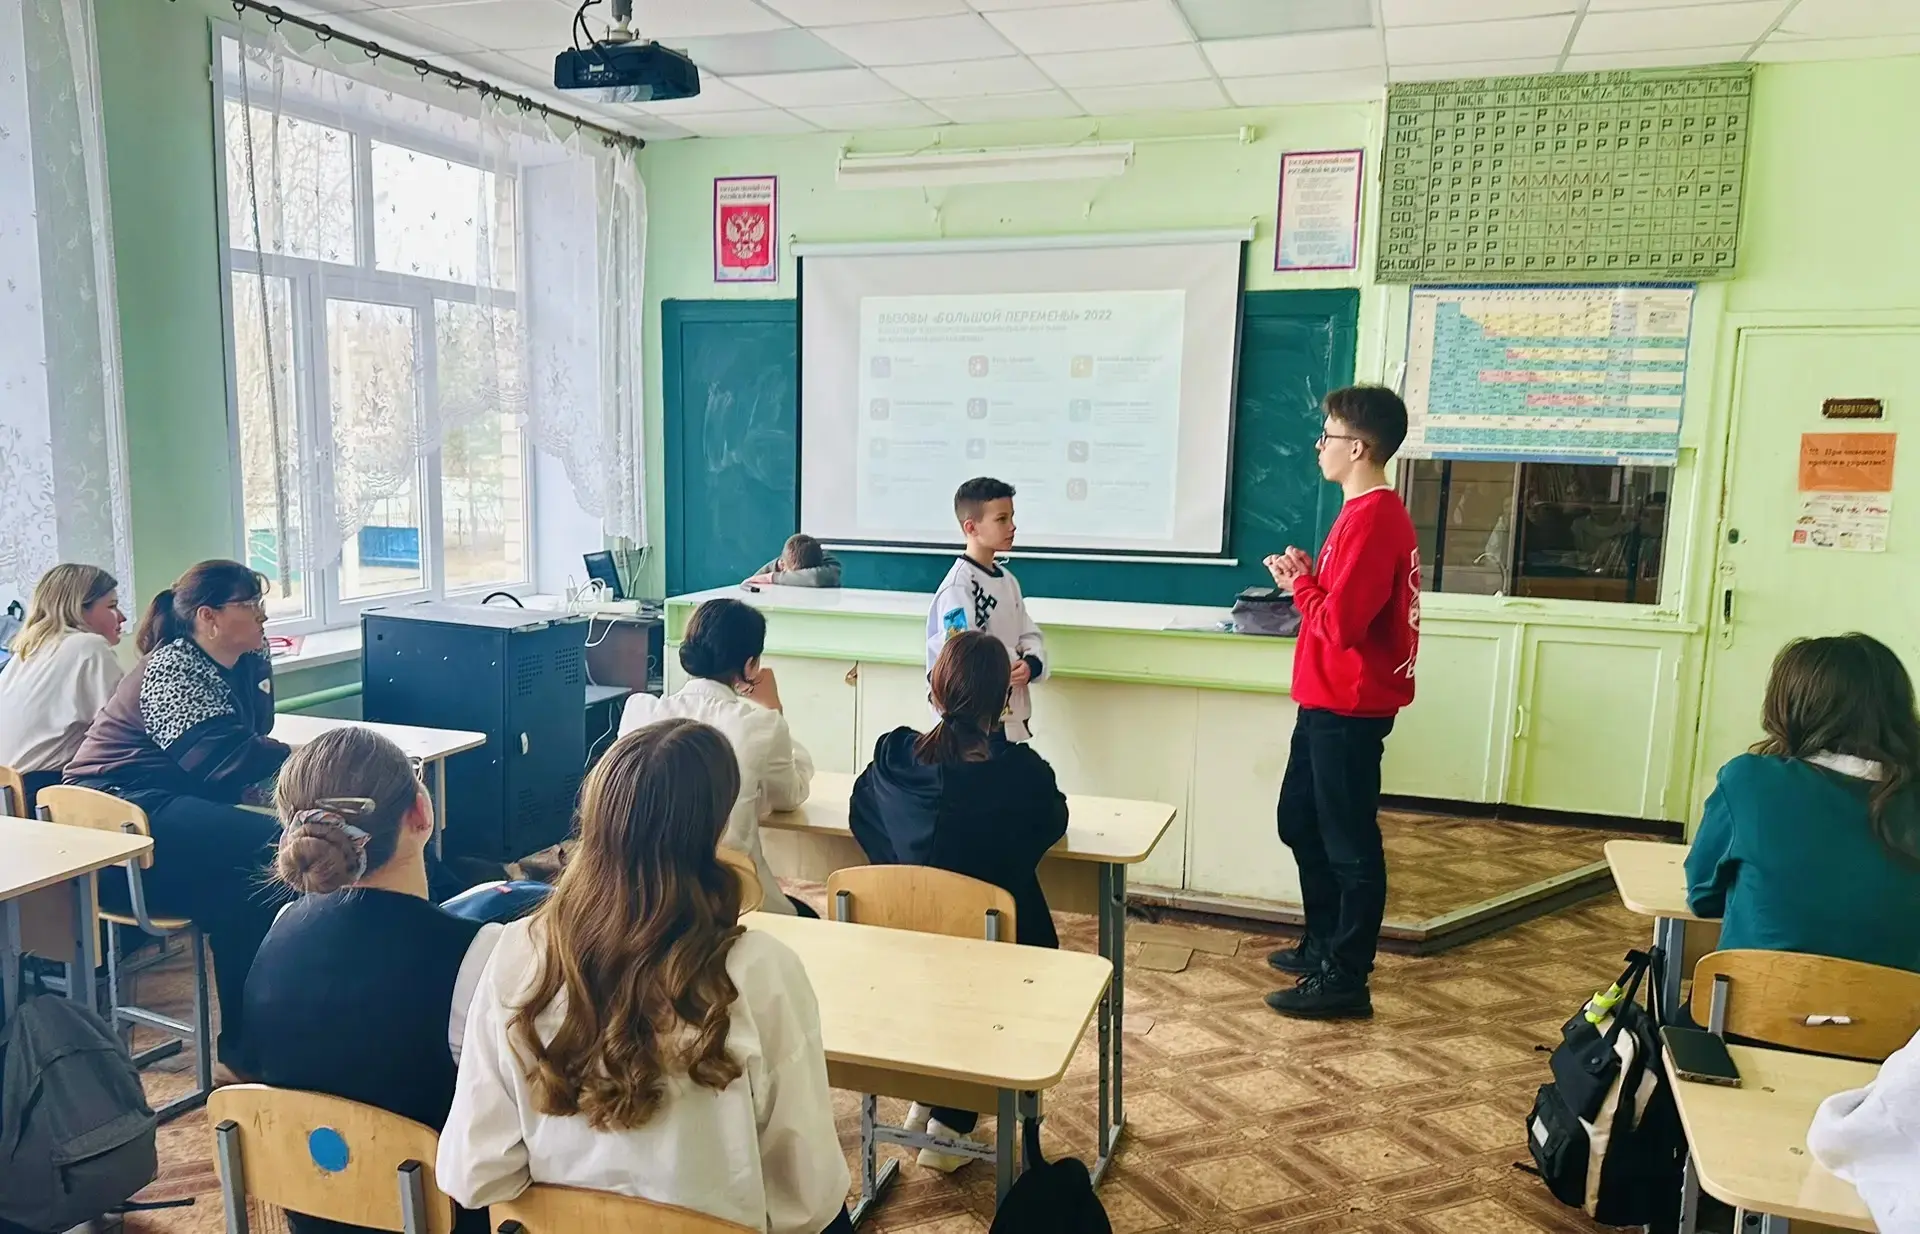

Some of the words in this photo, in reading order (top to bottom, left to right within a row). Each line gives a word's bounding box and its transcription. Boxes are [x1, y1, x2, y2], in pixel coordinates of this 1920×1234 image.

[1456, 112, 1466, 124] Р
[1476, 111, 1486, 123] Р
[1496, 110, 1506, 122] Р
[1537, 108, 1547, 120] Р
[1558, 108, 1572, 118] М
[1664, 102, 1678, 113] М
[1435, 129, 1446, 141] Р
[1455, 128, 1465, 140] Р
[1475, 127, 1486, 139] Р
[1495, 126, 1505, 138] Р
[1515, 125, 1526, 137] Р
[1536, 124, 1546, 136] Р
[1556, 123, 1567, 135] Р
[1578, 122, 1588, 134] Р
[1598, 121, 1608, 133] Р
[1619, 121, 1630, 133] Р
[1640, 120, 1650, 132] Р
[1662, 118, 1672, 130] Р
[1684, 118, 1694, 130] Р
[1705, 117, 1716, 129] Р
[1727, 116, 1738, 128] Р
[1434, 145, 1444, 157] Р
[1454, 145, 1464, 157] Р
[1474, 144, 1484, 156] Р
[1494, 143, 1504, 155] Р
[1534, 142, 1545, 154] Р
[1555, 140, 1566, 152] Р
[1576, 139, 1587, 151] Р
[1596, 138, 1607, 150] Р
[1617, 138, 1628, 150] Р
[1638, 136, 1649, 148] Р
[1661, 136, 1675, 147] М
[1682, 134, 1692, 146] Р
[1704, 133, 1714, 145] Р
[1726, 133, 1736, 145] Р
[1432, 161, 1443, 173] Р
[1452, 161, 1462, 173] Р
[1472, 160, 1483, 172] Р
[1492, 159, 1503, 171] Р
[1431, 178, 1442, 190] Р
[1451, 177, 1462, 189] Р
[1471, 176, 1482, 188] Р
[1491, 175, 1501, 187] Р
[1512, 176, 1526, 187] М
[1532, 175, 1546, 186] М
[1553, 174, 1567, 185] М
[1573, 173, 1588, 184] М
[1594, 173, 1609, 184] М
[1680, 169, 1694, 180] М
[1430, 194, 1440, 206] Р
[1450, 193, 1460, 205] Р
[1470, 193, 1480, 205] Р
[1490, 192, 1500, 204] Р
[1510, 192, 1525, 203] М
[1551, 191, 1566, 202] М
[1572, 190, 1582, 202] Р
[1592, 189, 1603, 201] Р
[1613, 188, 1624, 200] Р
[1656, 187, 1671, 198] М
[1678, 185, 1688, 197] Р
[1699, 184, 1710, 196] Р
[1721, 184, 1732, 196] Р
[1429, 210, 1439, 222] Р
[1449, 210, 1459, 222] Р
[1469, 209, 1479, 221] Р
[1488, 208, 1499, 220] Р
[1509, 208, 1524, 219] М
[1571, 207, 1585, 218] М
[1468, 225, 1478, 237] Р
[1487, 224, 1498, 236] Р
[1548, 224, 1563, 235] М
[1426, 242, 1437, 254] Р
[1446, 242, 1457, 254] Р
[1466, 241, 1477, 253] Р
[1486, 241, 1497, 253] Р
[1568, 240, 1582, 251] М
[1695, 236, 1710, 247] М
[1717, 236, 1732, 247] М
[1425, 258, 1436, 270] Р
[1445, 258, 1456, 270] Р
[1465, 257, 1476, 269] Р
[1484, 257, 1495, 269] Р
[1505, 256, 1515, 268] Р
[1525, 256, 1535, 268] Р
[1545, 256, 1556, 268] Р
[1566, 255, 1576, 267] Р
[1586, 255, 1597, 267] Р
[1607, 255, 1618, 267] Р
[1629, 254, 1639, 266] Р
[1650, 254, 1661, 266] Р
[1672, 253, 1682, 265] Р
[1693, 253, 1704, 265] Р
[1716, 252, 1726, 264] Р
[878, 313, 928, 324] ВЫЗОВЫ
[1084, 310, 1113, 321] 2022
